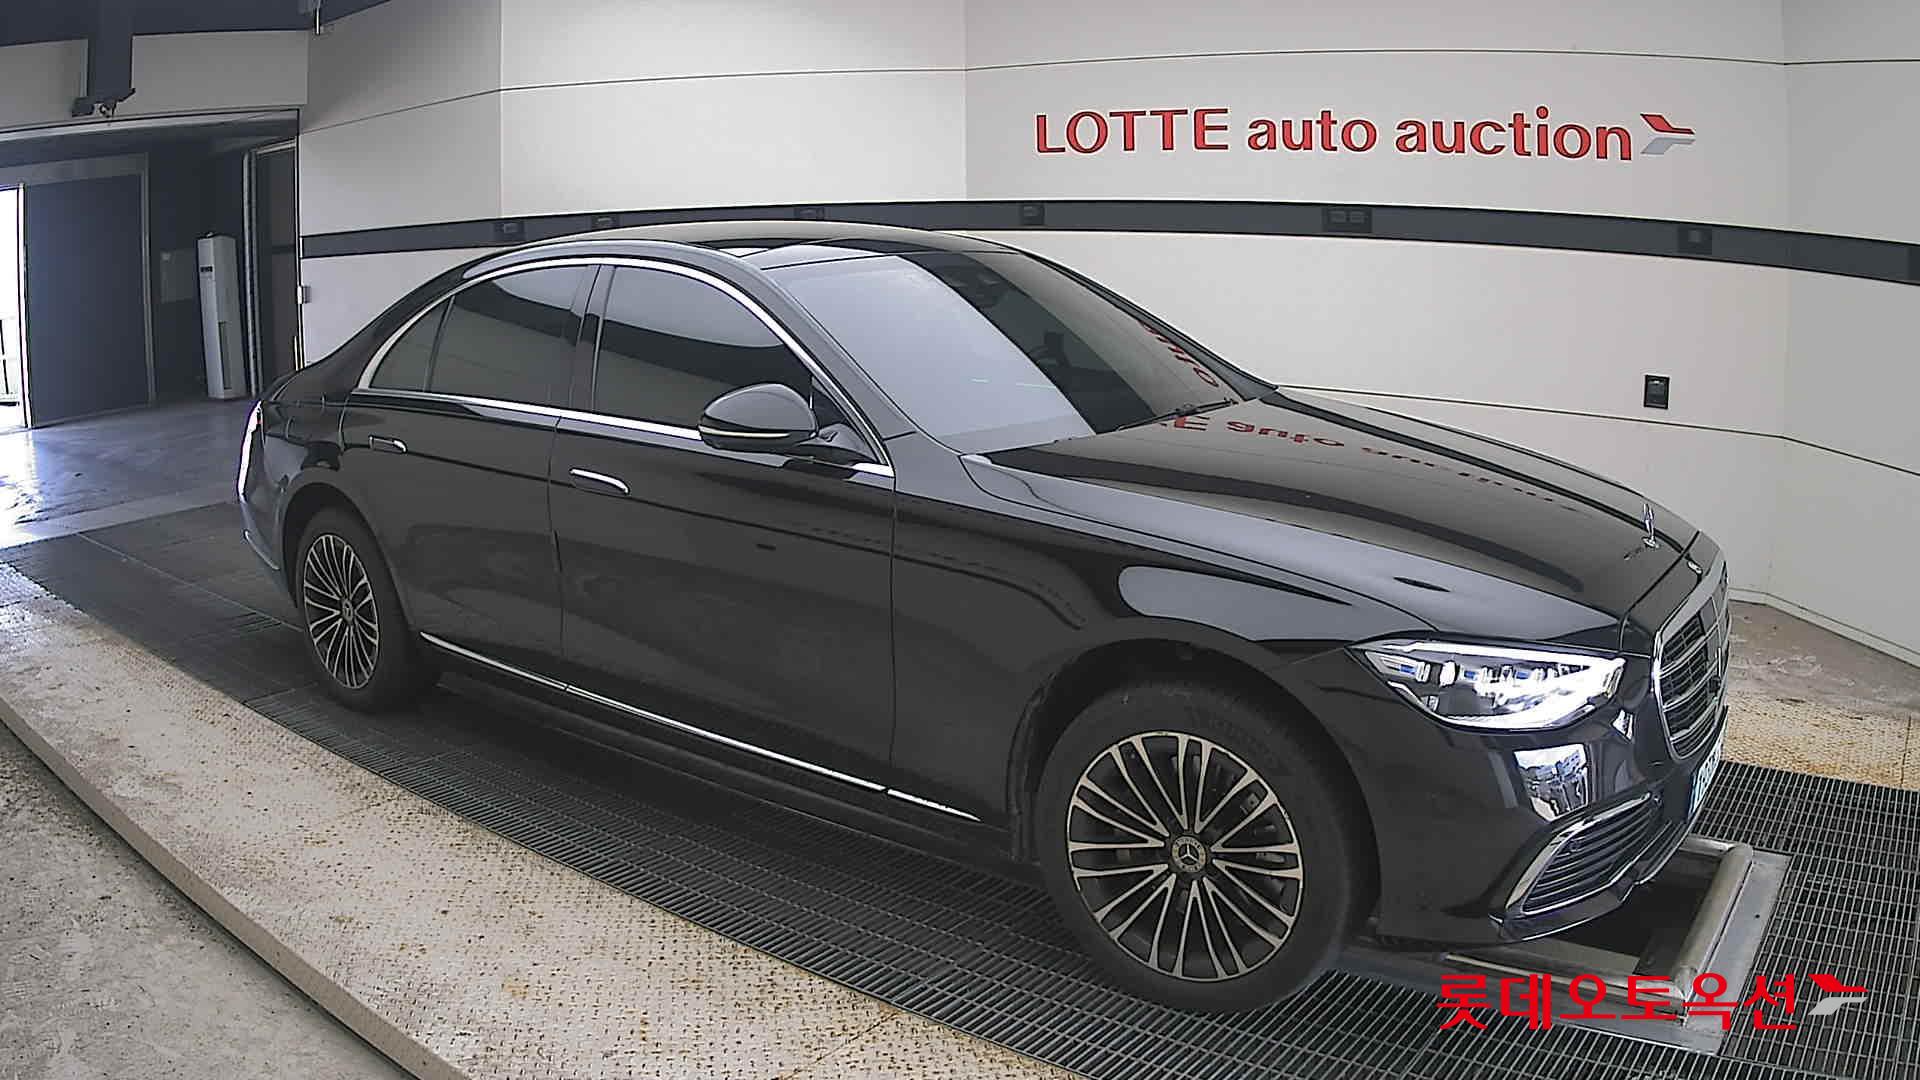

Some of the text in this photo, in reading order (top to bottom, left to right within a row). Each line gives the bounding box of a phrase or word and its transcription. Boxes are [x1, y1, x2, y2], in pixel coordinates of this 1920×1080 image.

[1035, 105, 1633, 161] LOTTE auto auction
